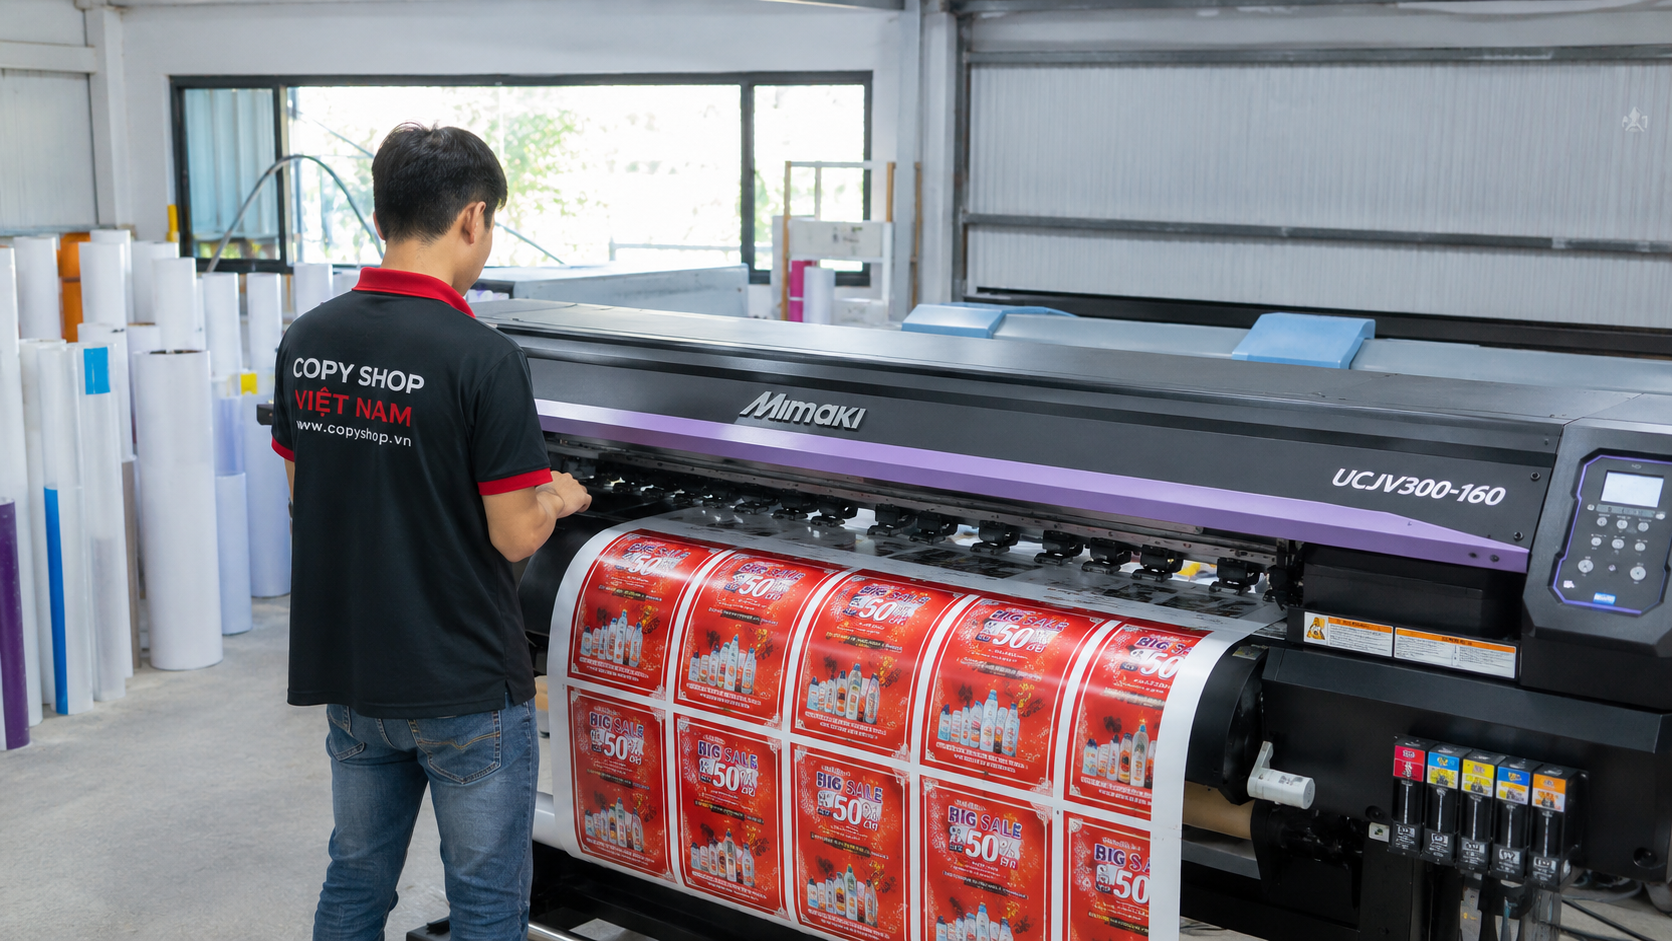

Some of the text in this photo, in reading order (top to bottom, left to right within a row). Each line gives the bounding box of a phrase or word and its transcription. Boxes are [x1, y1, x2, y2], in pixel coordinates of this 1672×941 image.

[293, 357, 425, 394] COPY SHOP
[295, 386, 412, 427] VIỆT NAM
[739, 391, 867, 429] Mimaki
[296, 420, 412, 447] www.copyshop.vn
[1332, 468, 1506, 506] UCJV300-160
[980, 814, 1022, 838] SALE
